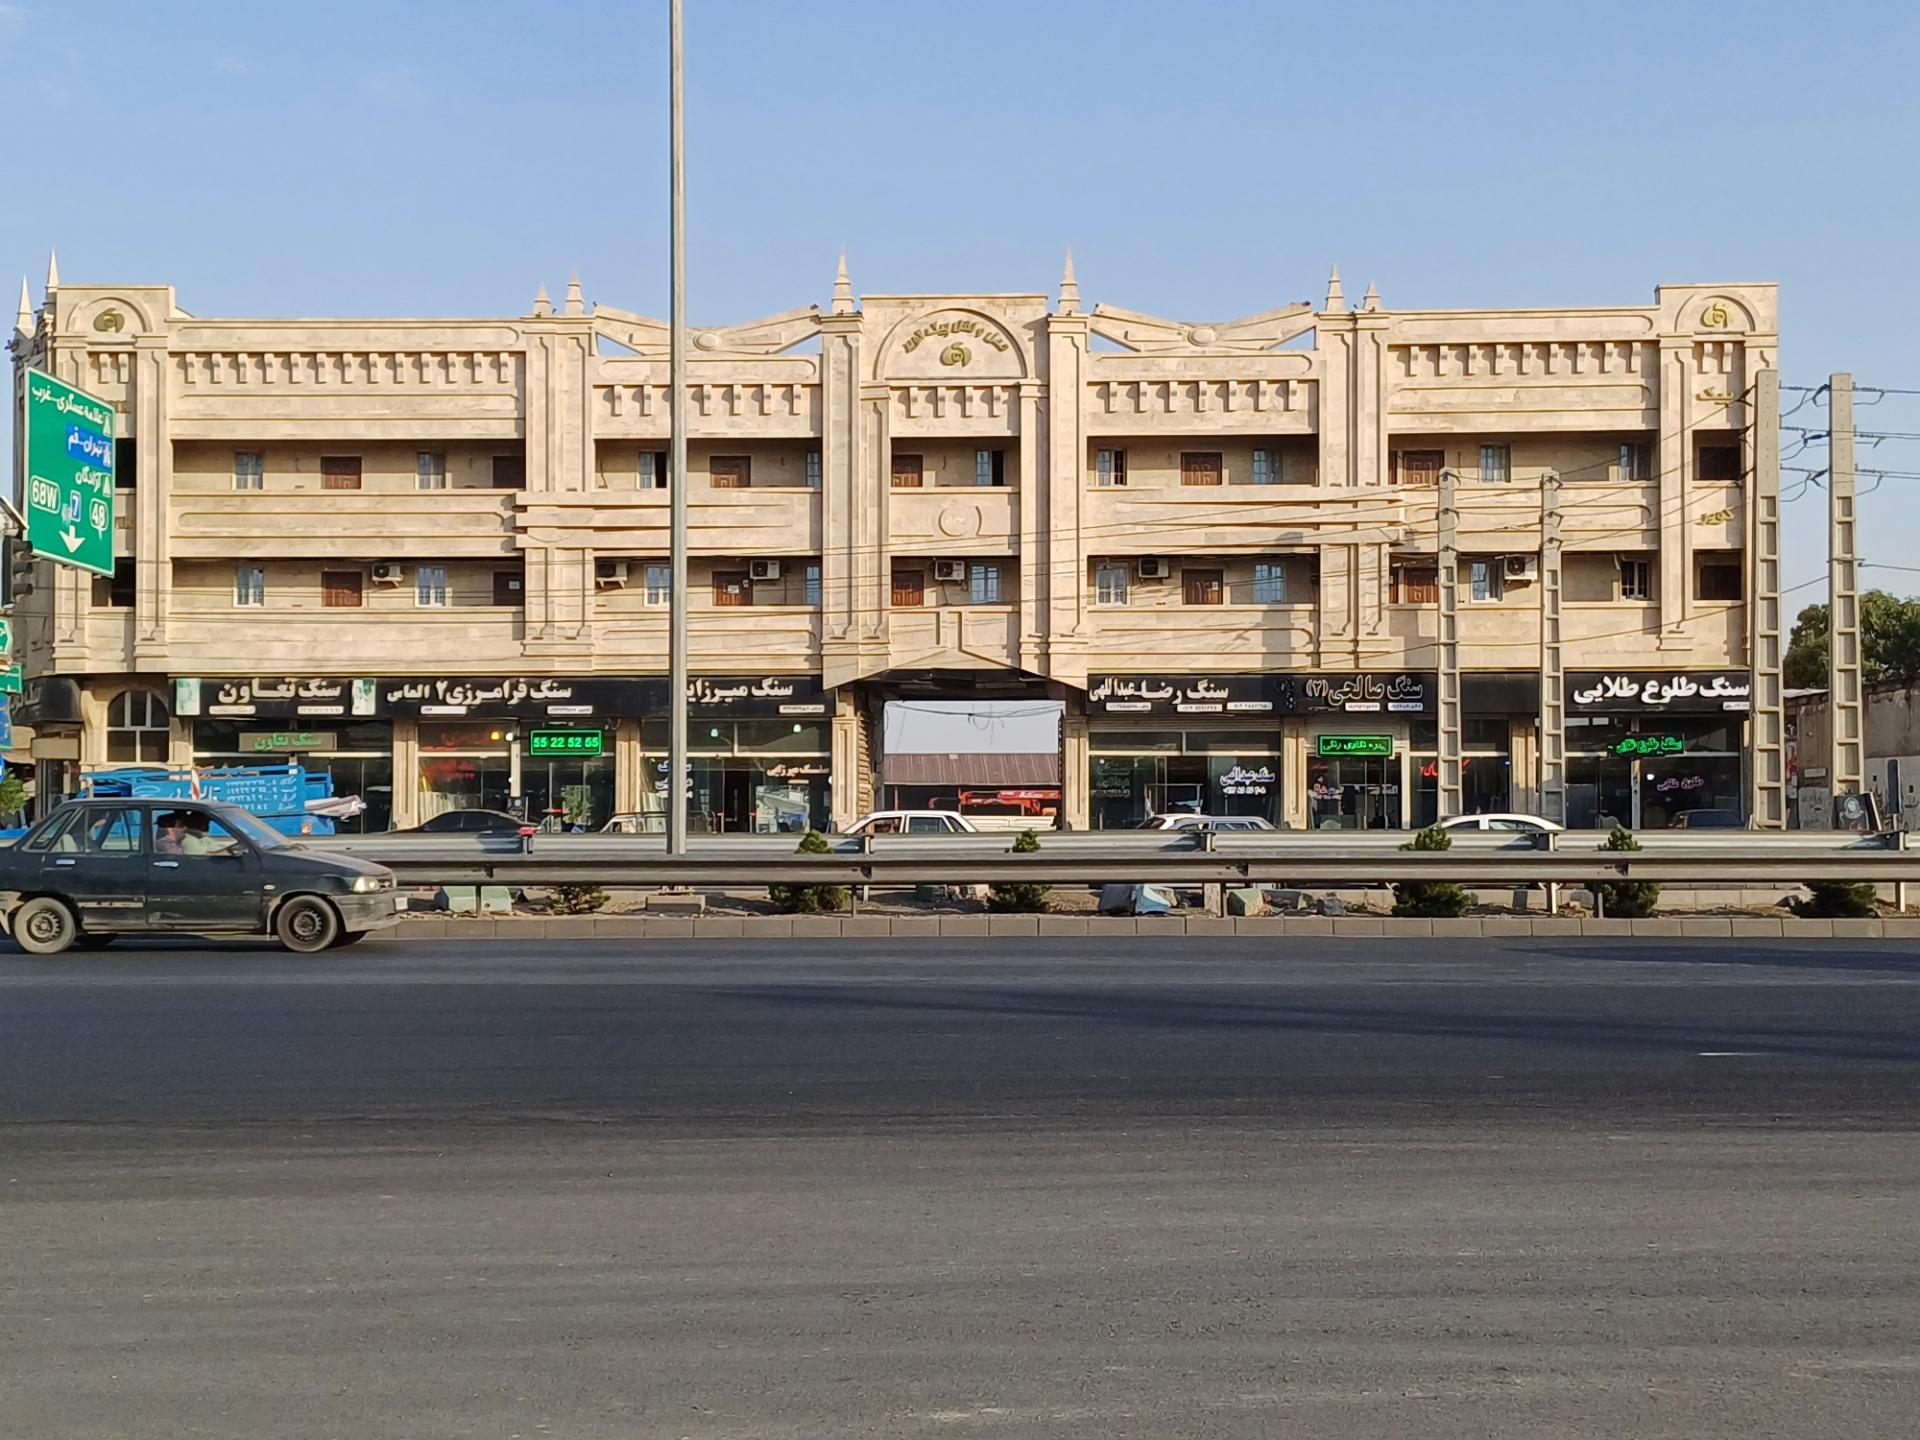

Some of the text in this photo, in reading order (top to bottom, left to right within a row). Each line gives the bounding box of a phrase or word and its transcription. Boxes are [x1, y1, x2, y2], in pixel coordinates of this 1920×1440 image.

[31, 480, 58, 510] 68W
[218, 677, 342, 703] سنگ تعاون
[530, 679, 572, 699] سنگ
[686, 677, 793, 703] سنگ میرزای
[1186, 679, 1229, 700] سنگ
[1386, 675, 1423, 699] سنگ
[1573, 676, 1750, 704] سنگ طلوع طلایی
[254, 732, 322, 751] سنگ تعاون
[533, 736, 548, 748] 55
[550, 736, 565, 748] 22
[567, 736, 582, 748] 52
